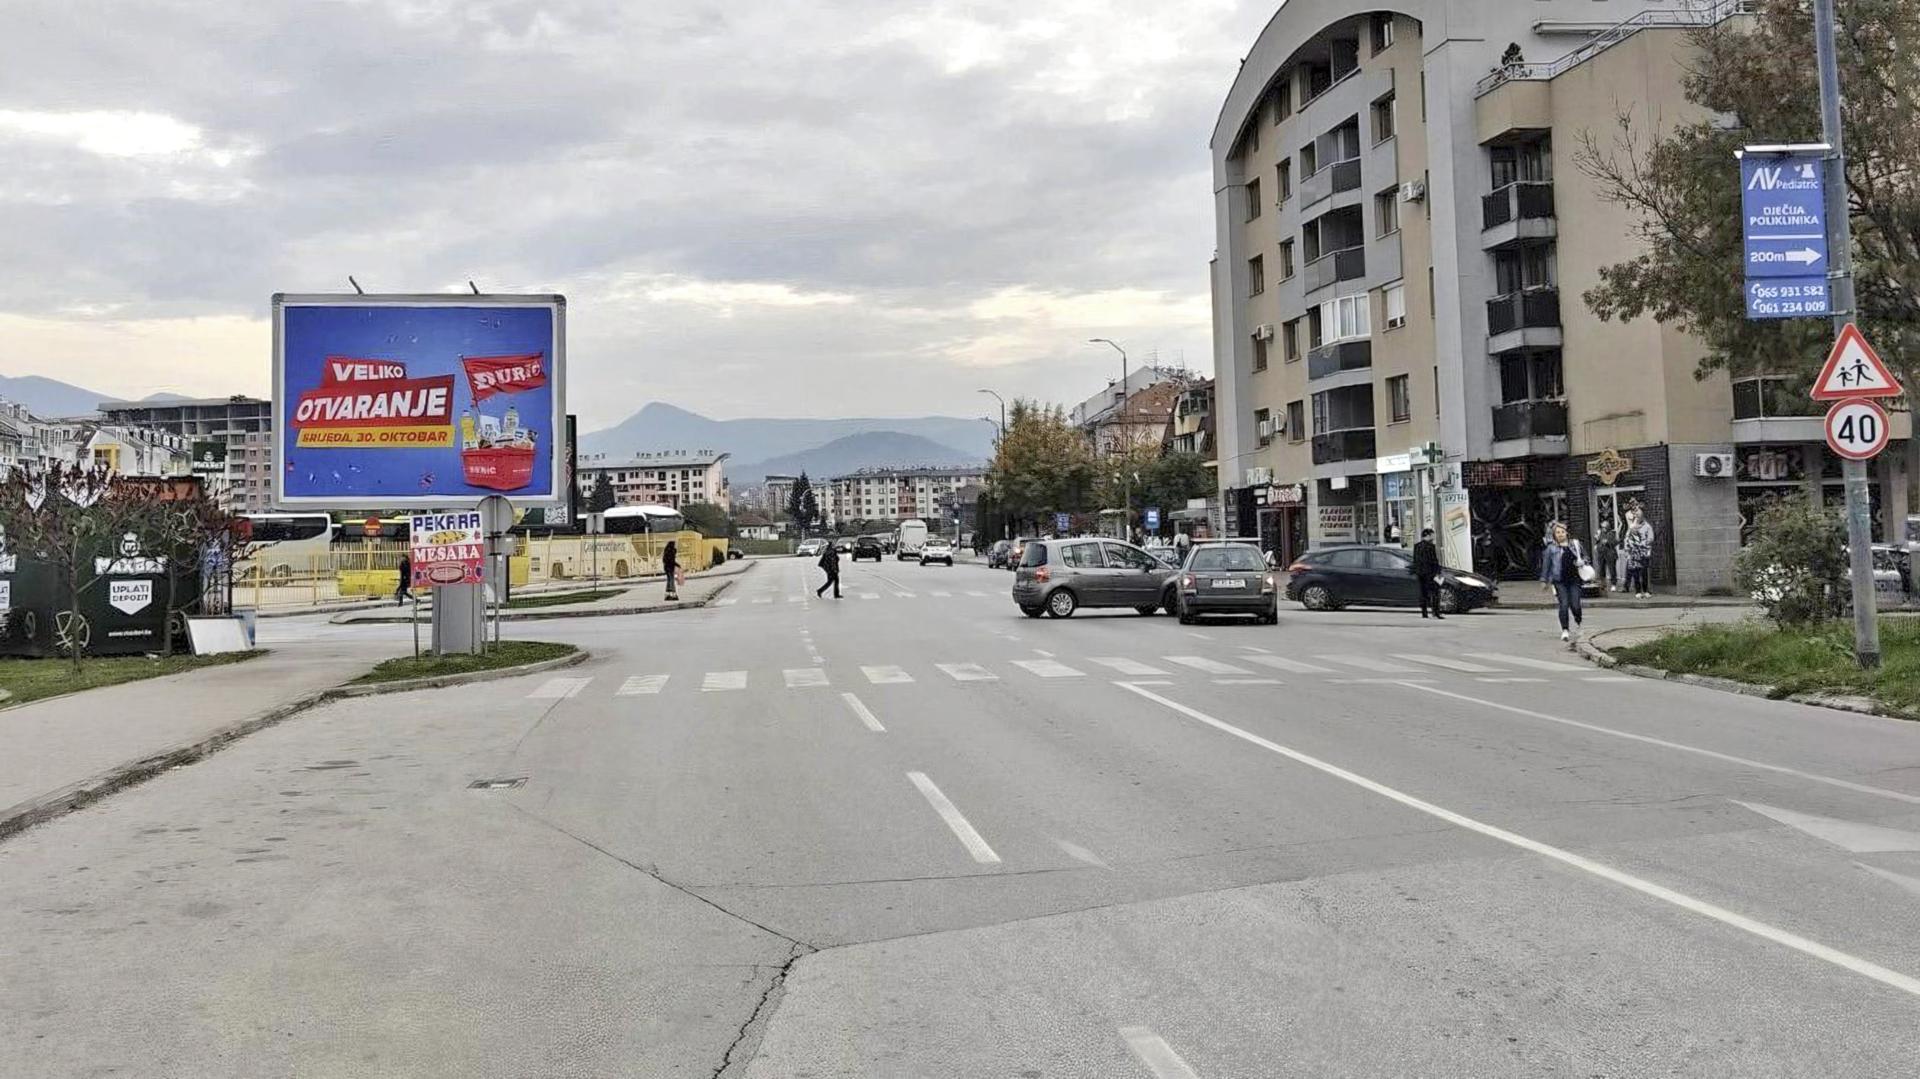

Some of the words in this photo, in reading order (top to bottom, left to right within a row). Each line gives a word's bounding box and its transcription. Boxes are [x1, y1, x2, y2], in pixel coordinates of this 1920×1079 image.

[1748, 167, 1781, 190] AV
[1776, 179, 1818, 190] Pediatric
[1763, 203, 1805, 216] DJEČIJA
[1750, 215, 1819, 226] POLIKLINIKA
[1750, 251, 1785, 262] 200m
[1780, 286, 1801, 297] 931
[1803, 285, 1825, 296] 582
[1759, 303, 1779, 313] 061
[1782, 302, 1802, 313] 234
[1805, 301, 1825, 312] 009
[332, 362, 404, 382] VELIKO
[297, 387, 448, 421] OTVARANJE
[1838, 414, 1876, 443] 40
[380, 431, 447, 442] OKTOBAR
[413, 513, 480, 532] PEKARA
[413, 545, 480, 563] MESARA
[112, 584, 149, 594] UPLATI
[112, 594, 149, 602] DEPOZIT
